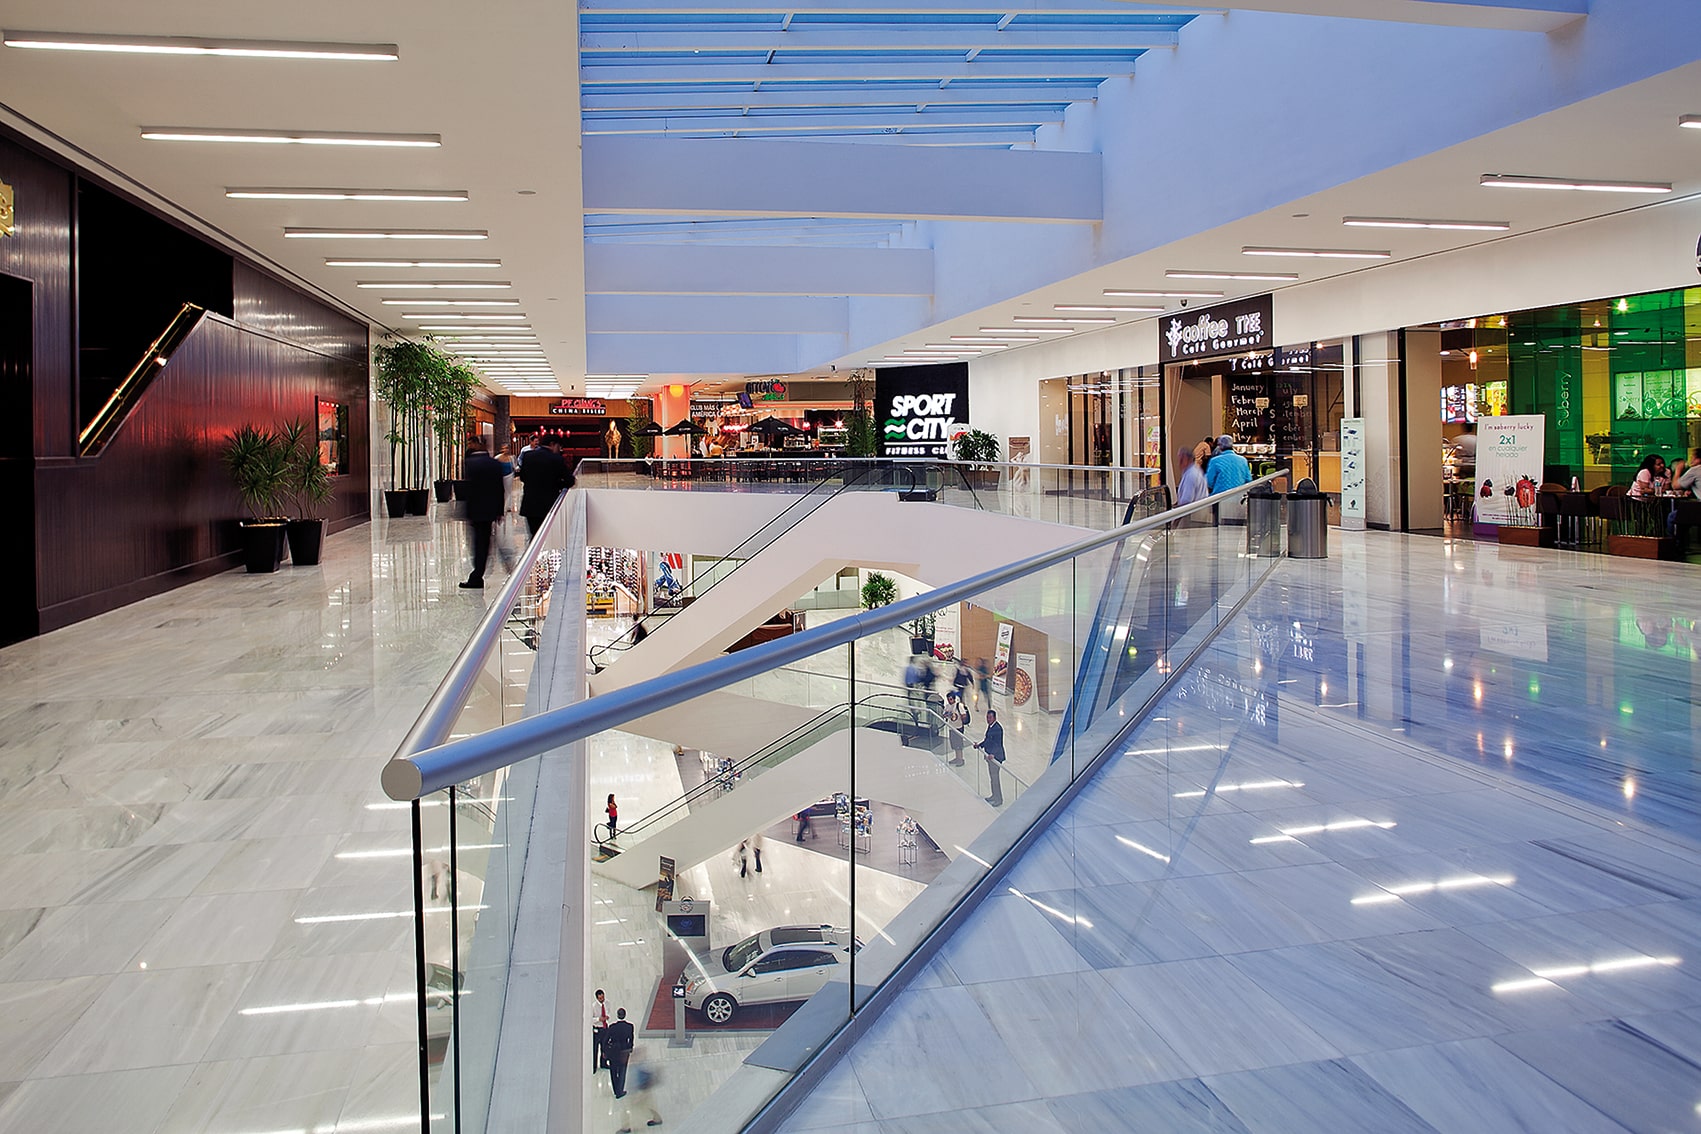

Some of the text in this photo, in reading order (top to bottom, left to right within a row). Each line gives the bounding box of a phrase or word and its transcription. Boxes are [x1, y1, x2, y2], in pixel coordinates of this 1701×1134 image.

[1183, 312, 1261, 344] coffee TREE
[1182, 336, 1261, 355] Café Gourmet
[1231, 384, 1265, 394] January
[890, 393, 957, 418] SPORT
[1236, 407, 1263, 416] March
[906, 416, 956, 441] CITY
[1231, 417, 1258, 431] April
[1517, 422, 1534, 431] lucky
[1232, 432, 1252, 443] May
[1499, 434, 1516, 445] 2x1
[885, 446, 926, 456] FITNESS
[1497, 444, 1528, 453] cualquier
